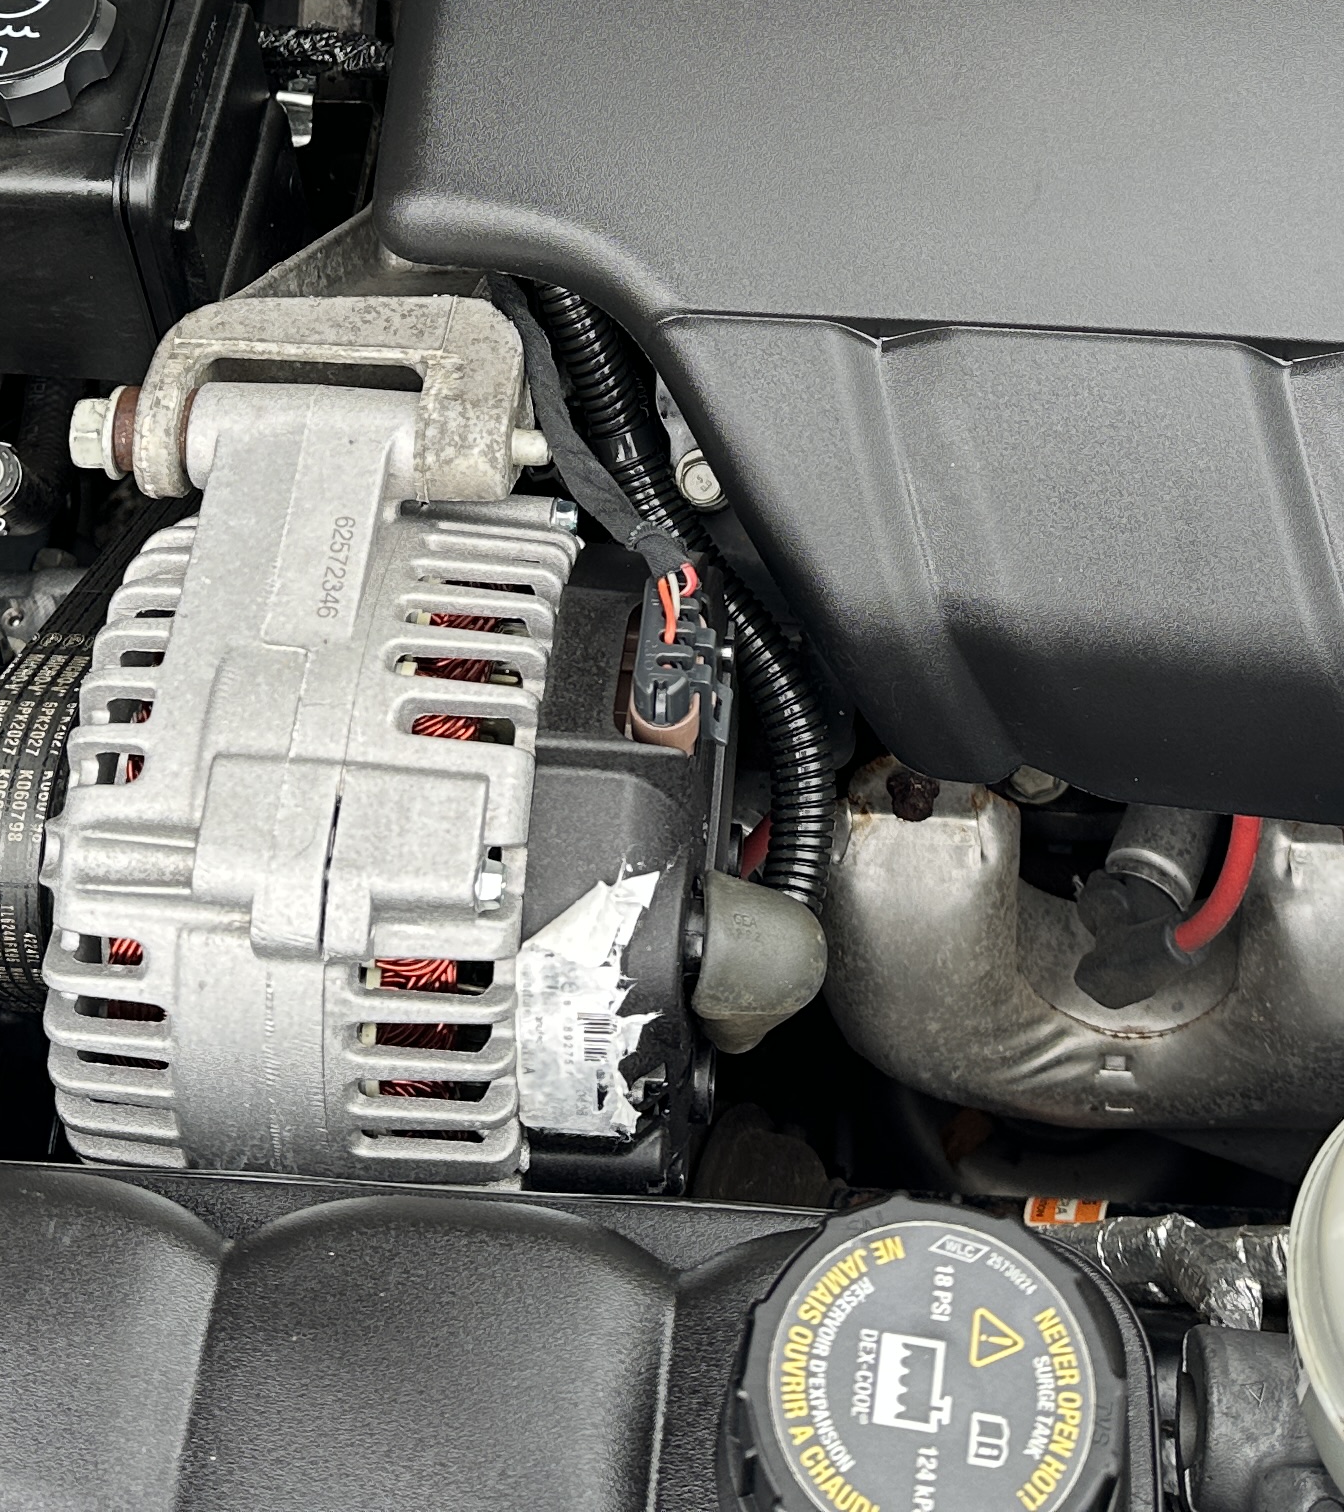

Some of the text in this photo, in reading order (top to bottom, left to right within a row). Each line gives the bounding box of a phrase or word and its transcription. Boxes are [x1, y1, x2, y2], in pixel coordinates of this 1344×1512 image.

[317, 515, 356, 620] 62572346
[2, 700, 35, 755] 6PK2027
[26, 701, 58, 756] 6PK2027
[8, 769, 34, 842] K060798
[869, 1236, 906, 1266] NE
[944, 1241, 976, 1258] WLC
[797, 1248, 868, 1325] JAMAIS
[929, 1264, 955, 1322] 18 PSI
[780, 1325, 815, 1420] OUVRIR
[1015, 1306, 1083, 1511] NEVER OPEN HOT!
[1023, 1355, 1056, 1462] SURGE TANK
[808, 1360, 856, 1473] D'EXPANSION
[915, 1445, 939, 1481] 124
